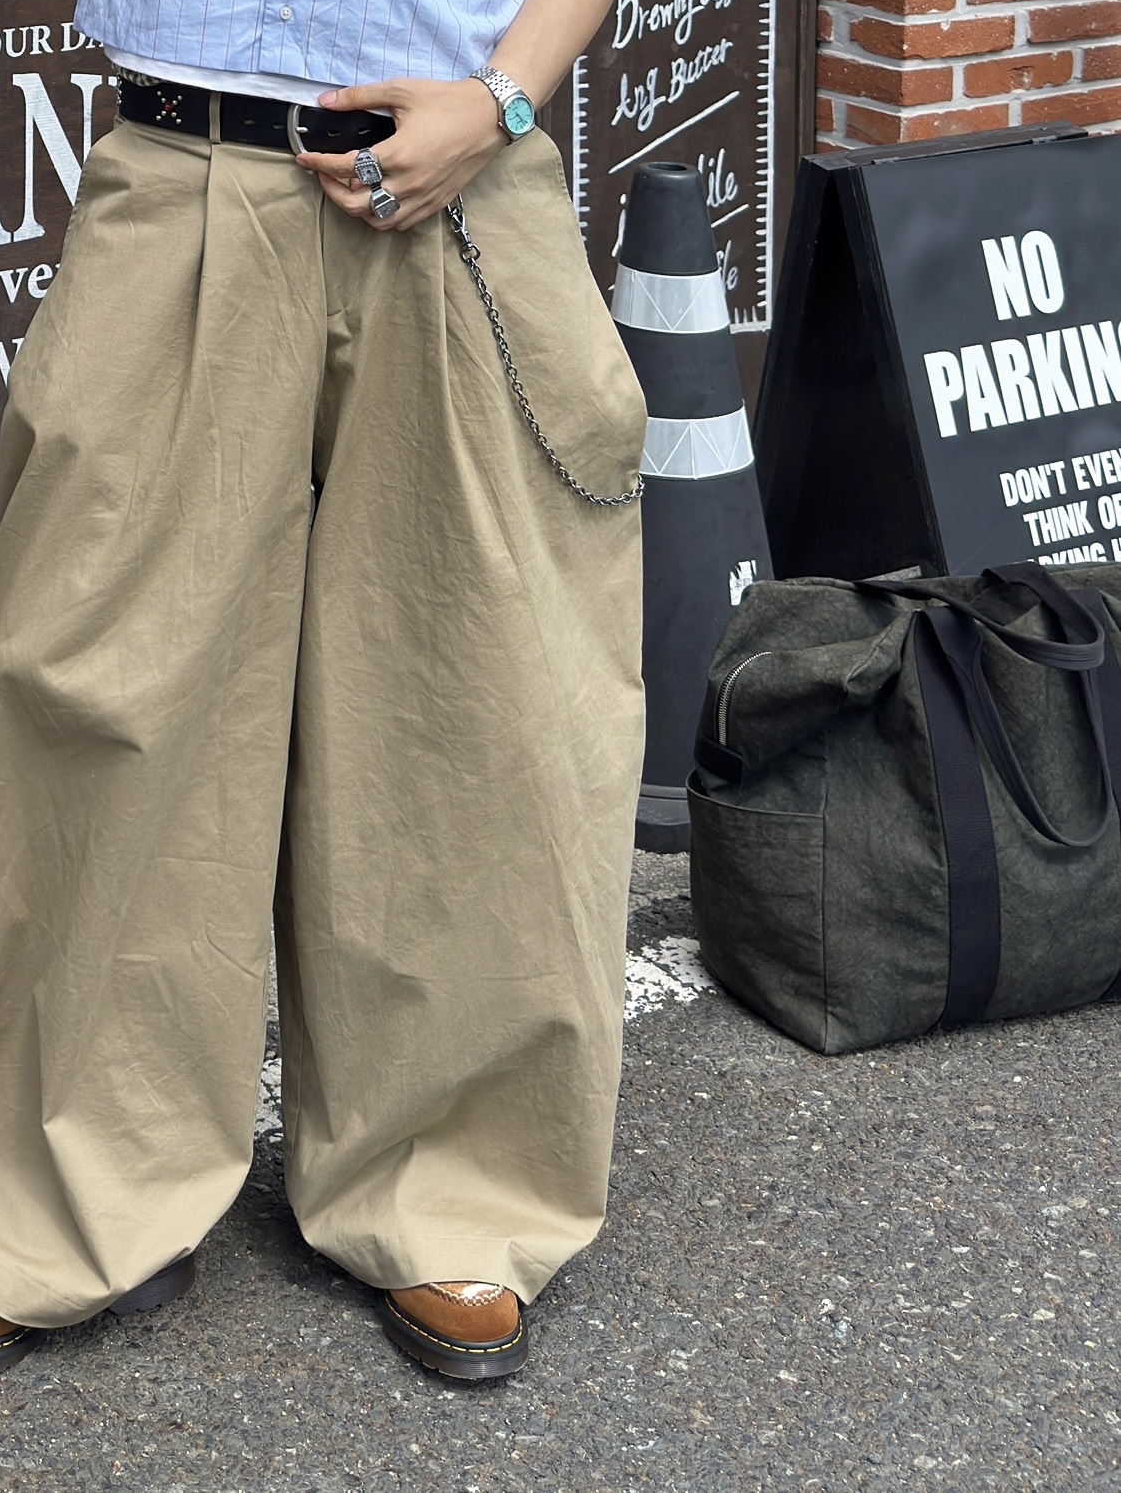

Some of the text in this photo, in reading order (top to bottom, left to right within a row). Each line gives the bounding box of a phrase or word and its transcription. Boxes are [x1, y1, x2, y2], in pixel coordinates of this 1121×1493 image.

[667, 38, 733, 103] Butter
[981, 229, 1065, 321] NO
[923, 320, 1121, 438] PARKIN
[999, 460, 1067, 508] DON'T
[1022, 500, 1095, 547] THINK
